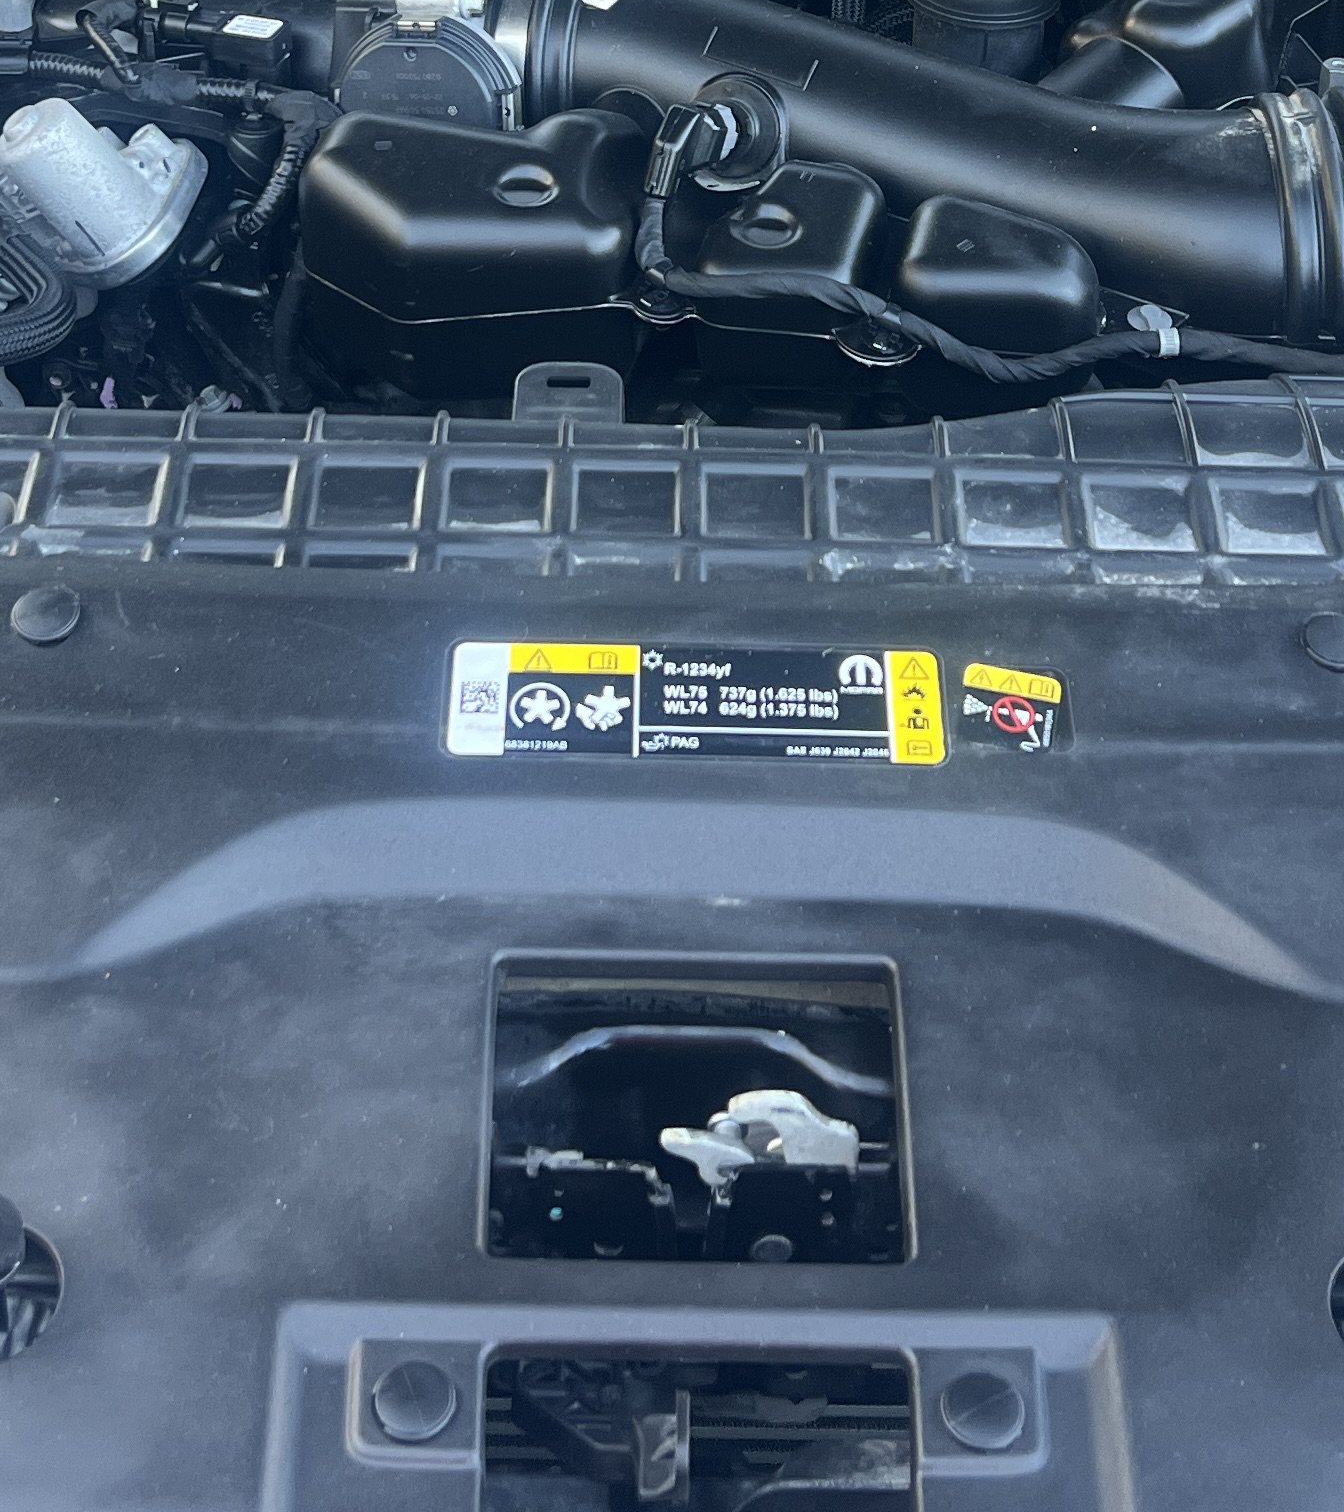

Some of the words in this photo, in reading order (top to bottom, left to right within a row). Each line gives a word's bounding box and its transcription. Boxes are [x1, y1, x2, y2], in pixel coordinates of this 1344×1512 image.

[663, 684, 708, 700] WL75
[719, 686, 757, 703] 737g
[759, 687, 806, 703] (1.625
[808, 688, 839, 704] lbs)
[663, 700, 708, 715] WL74
[718, 701, 757, 719] 624g
[759, 702, 807, 719] (1.375
[808, 703, 840, 721] lbs)
[670, 735, 700, 750] PAG
